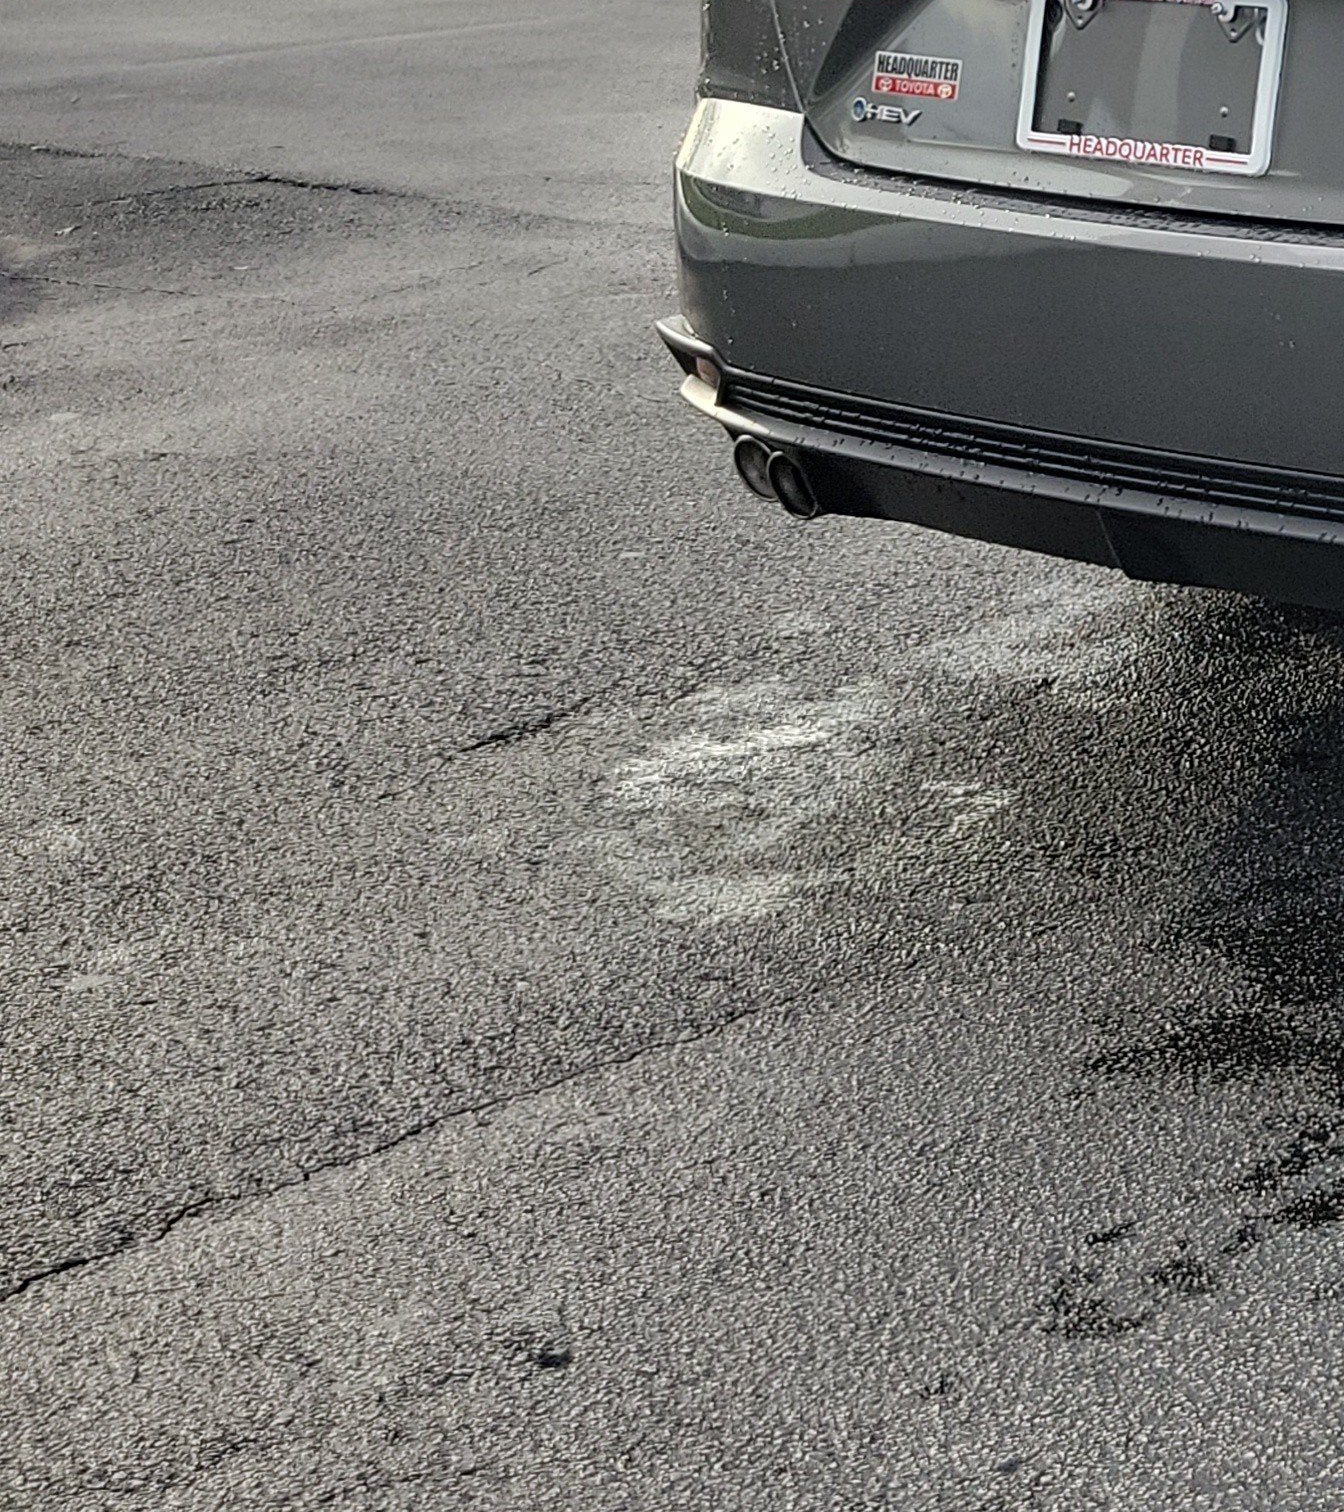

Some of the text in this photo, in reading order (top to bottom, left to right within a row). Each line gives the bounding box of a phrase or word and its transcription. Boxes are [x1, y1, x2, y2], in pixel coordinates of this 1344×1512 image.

[877, 54, 960, 81] HEADQUARTER
[895, 80, 935, 95] TOYOTA
[1069, 135, 1204, 166] HEADQUARTER
